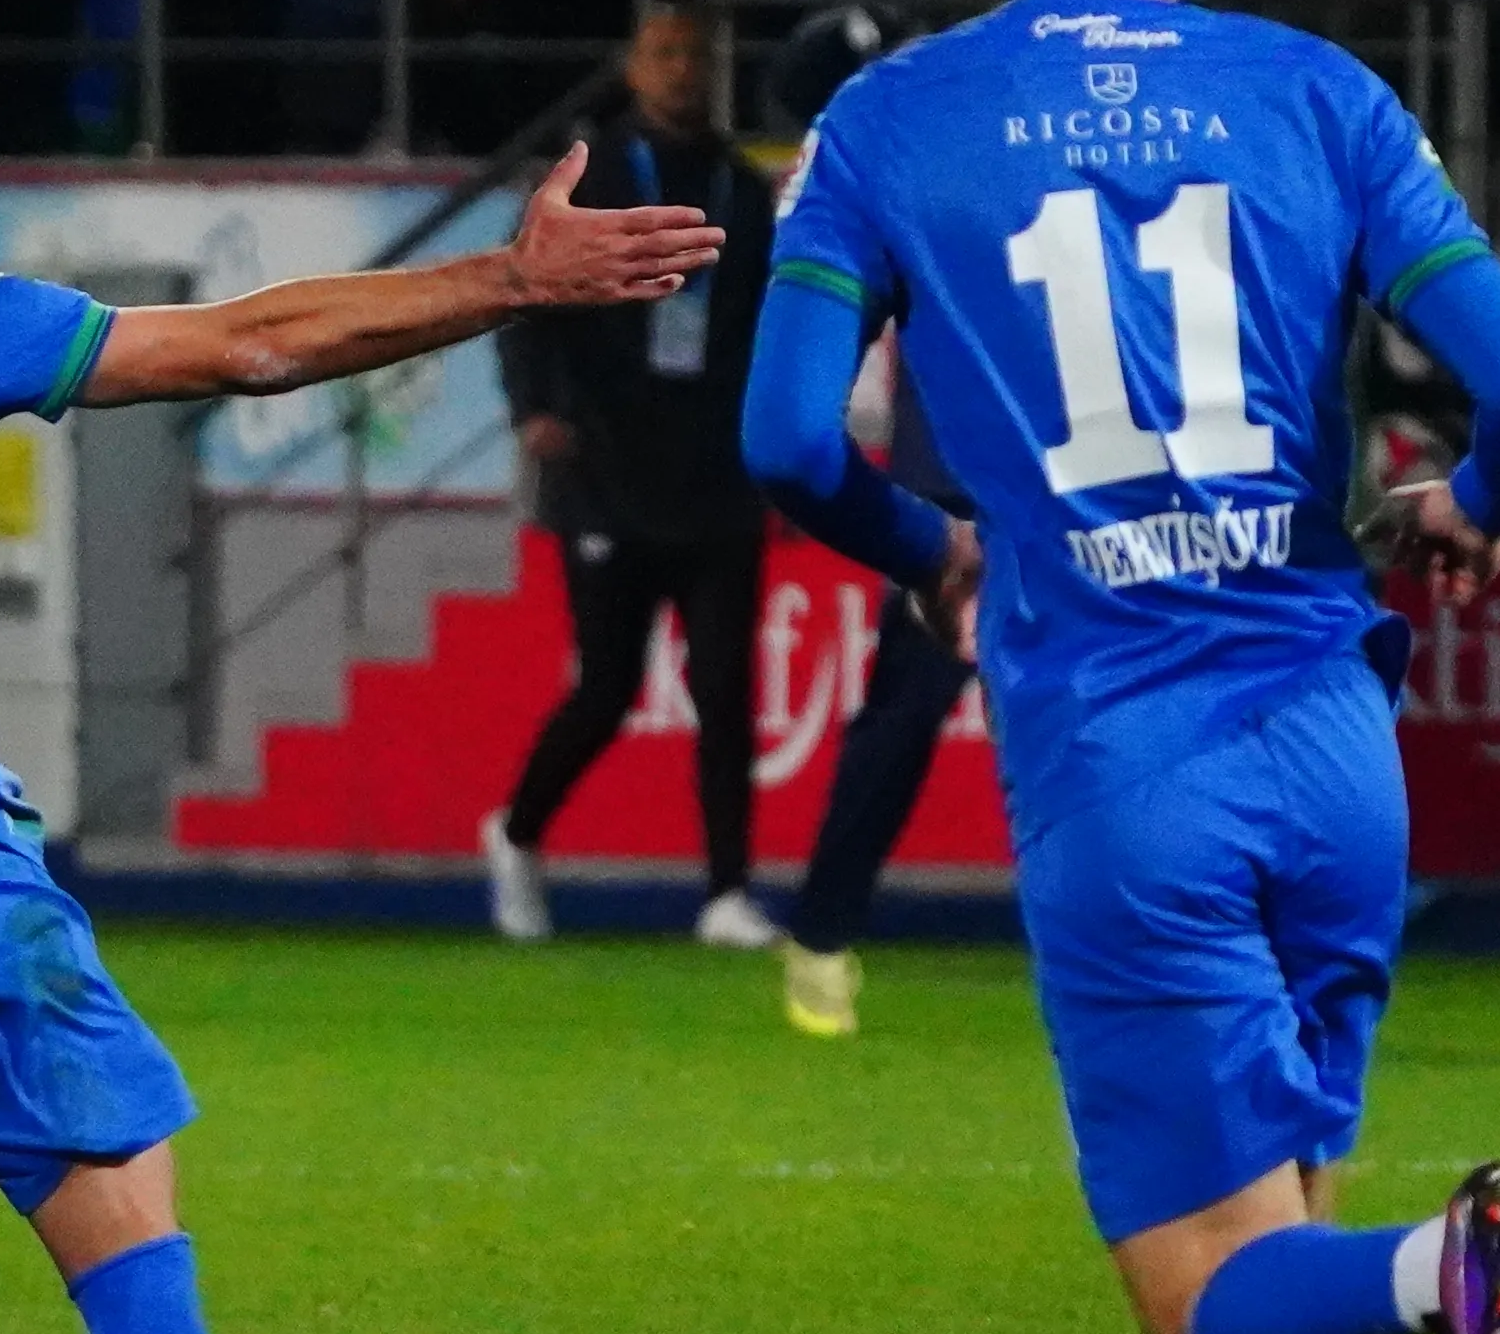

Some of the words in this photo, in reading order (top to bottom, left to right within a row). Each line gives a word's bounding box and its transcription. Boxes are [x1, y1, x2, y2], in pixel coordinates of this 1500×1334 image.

[1006, 105, 1230, 145] RICOSTA
[1064, 139, 1182, 167] HOTEL
[1006, 183, 1275, 495] 11
